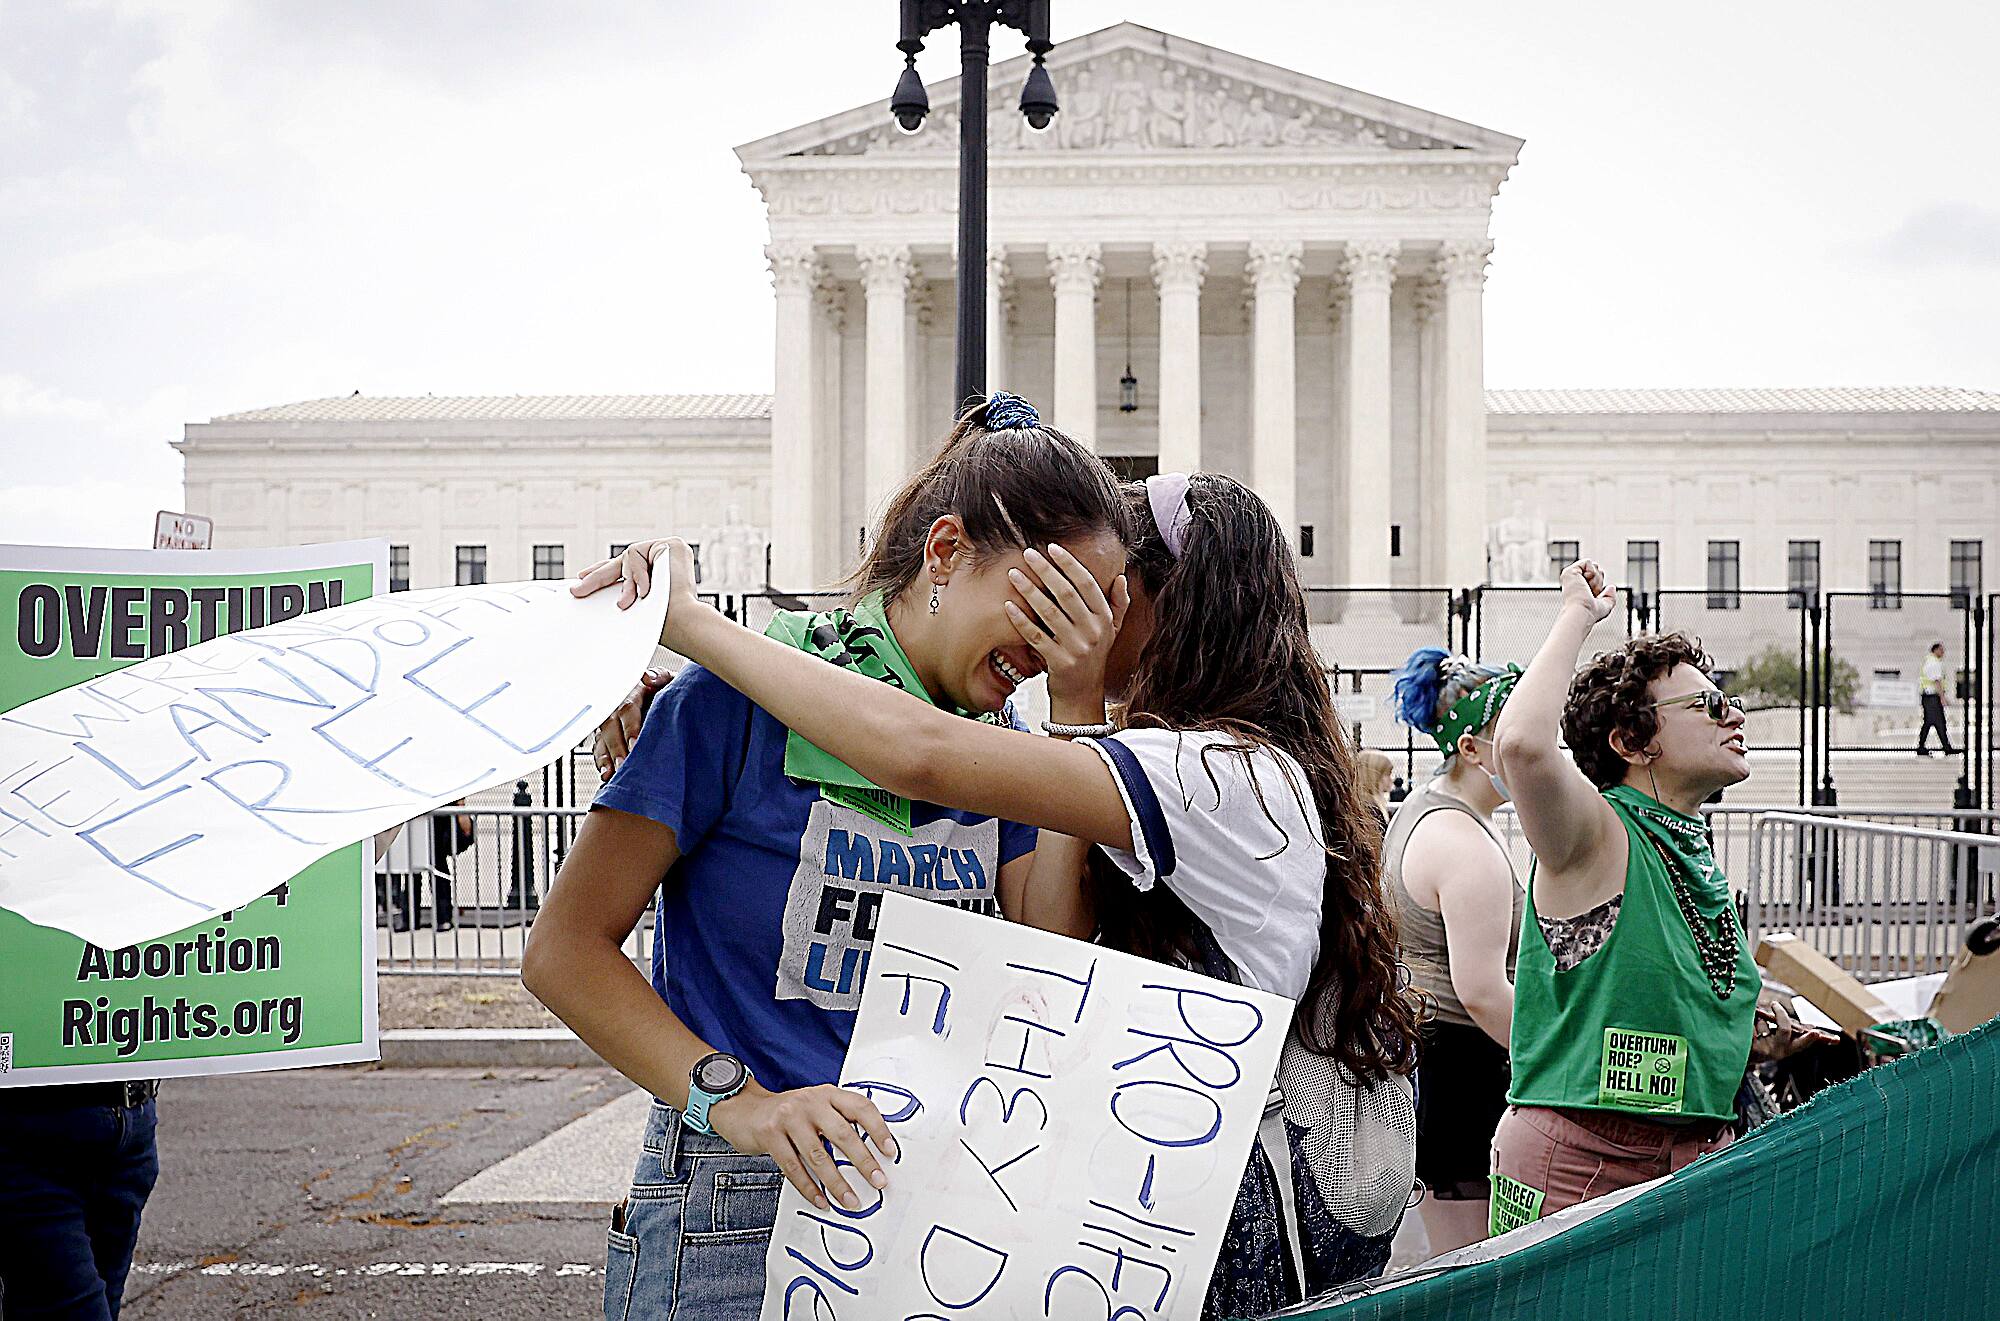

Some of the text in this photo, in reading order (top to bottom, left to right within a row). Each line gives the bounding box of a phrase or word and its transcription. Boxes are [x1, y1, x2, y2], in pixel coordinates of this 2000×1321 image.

[173, 519, 195, 537] NO
[72, 636, 382, 791] LAND
[76, 635, 592, 911] FREE
[824, 829, 988, 891] MARCH
[62, 996, 304, 1057] Rights.org
[1609, 1032, 1678, 1056] OVERTURN
[1606, 1069, 1677, 1097] HELL NO!
[1608, 1050, 1643, 1069] ROE?
[959, 958, 1097, 1212] THEY
[1496, 1176, 1536, 1210] FORCED
